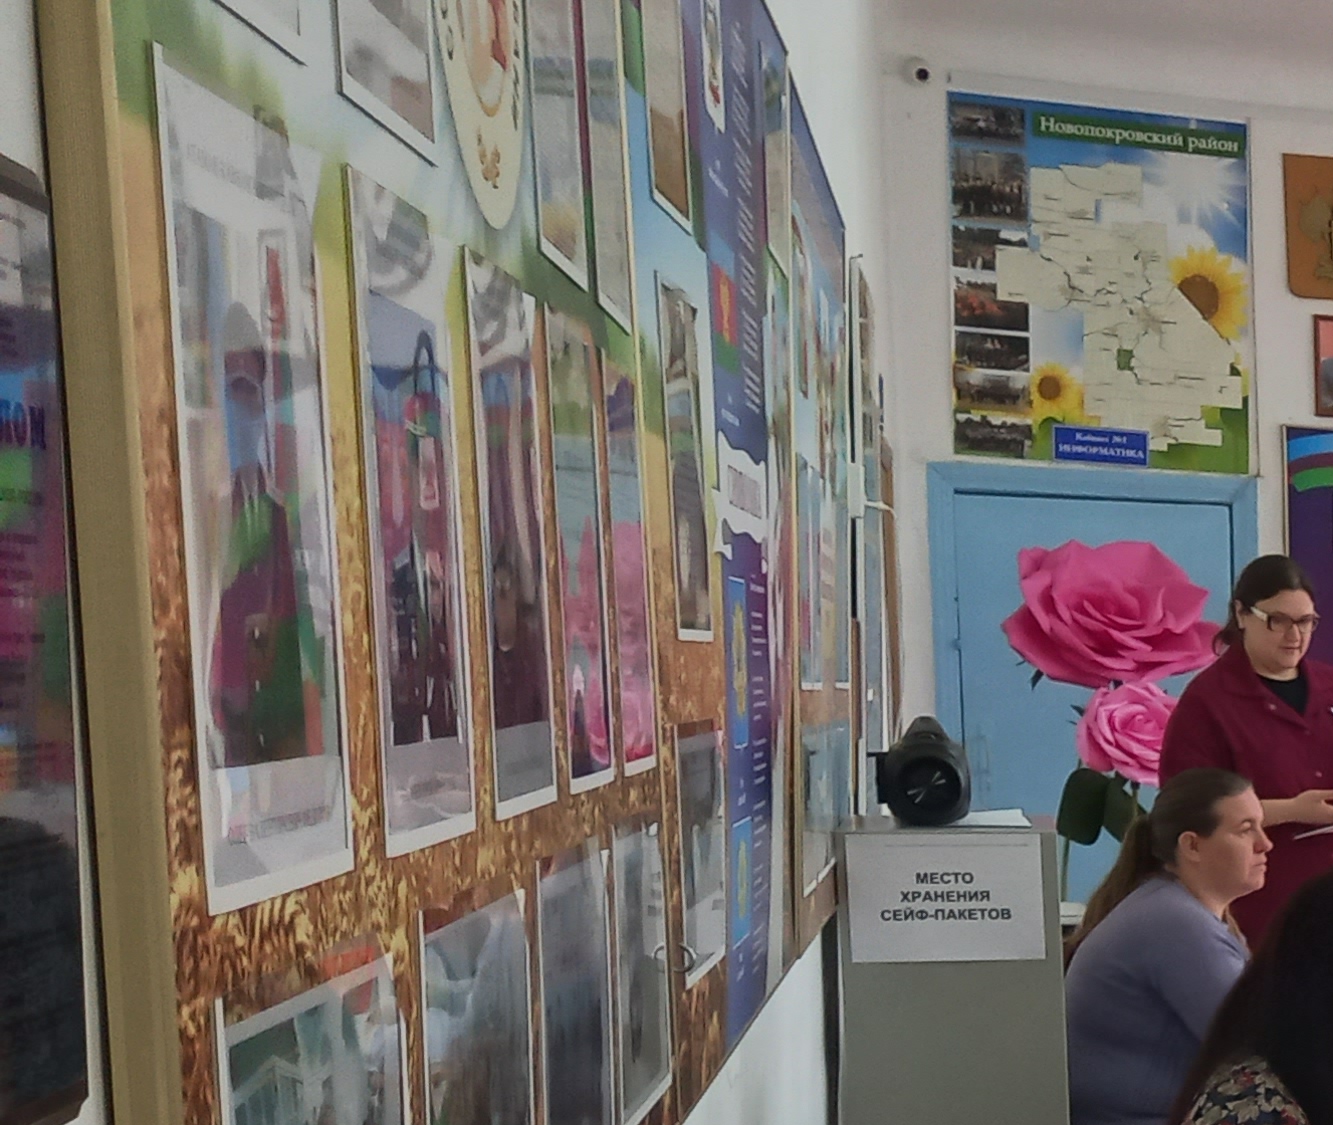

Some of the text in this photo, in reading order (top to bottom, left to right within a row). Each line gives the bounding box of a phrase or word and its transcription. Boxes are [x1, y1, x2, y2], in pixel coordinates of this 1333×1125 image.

[1039, 115, 1239, 153] Новопокровский район
[1058, 443, 1145, 459] ИНФОРМАТИКА
[915, 872, 975, 885] МЕСТО
[899, 889, 991, 903] ХРАНЕНИЯ
[879, 906, 1012, 922] СЕЙФ-ПАКЕТОВ
